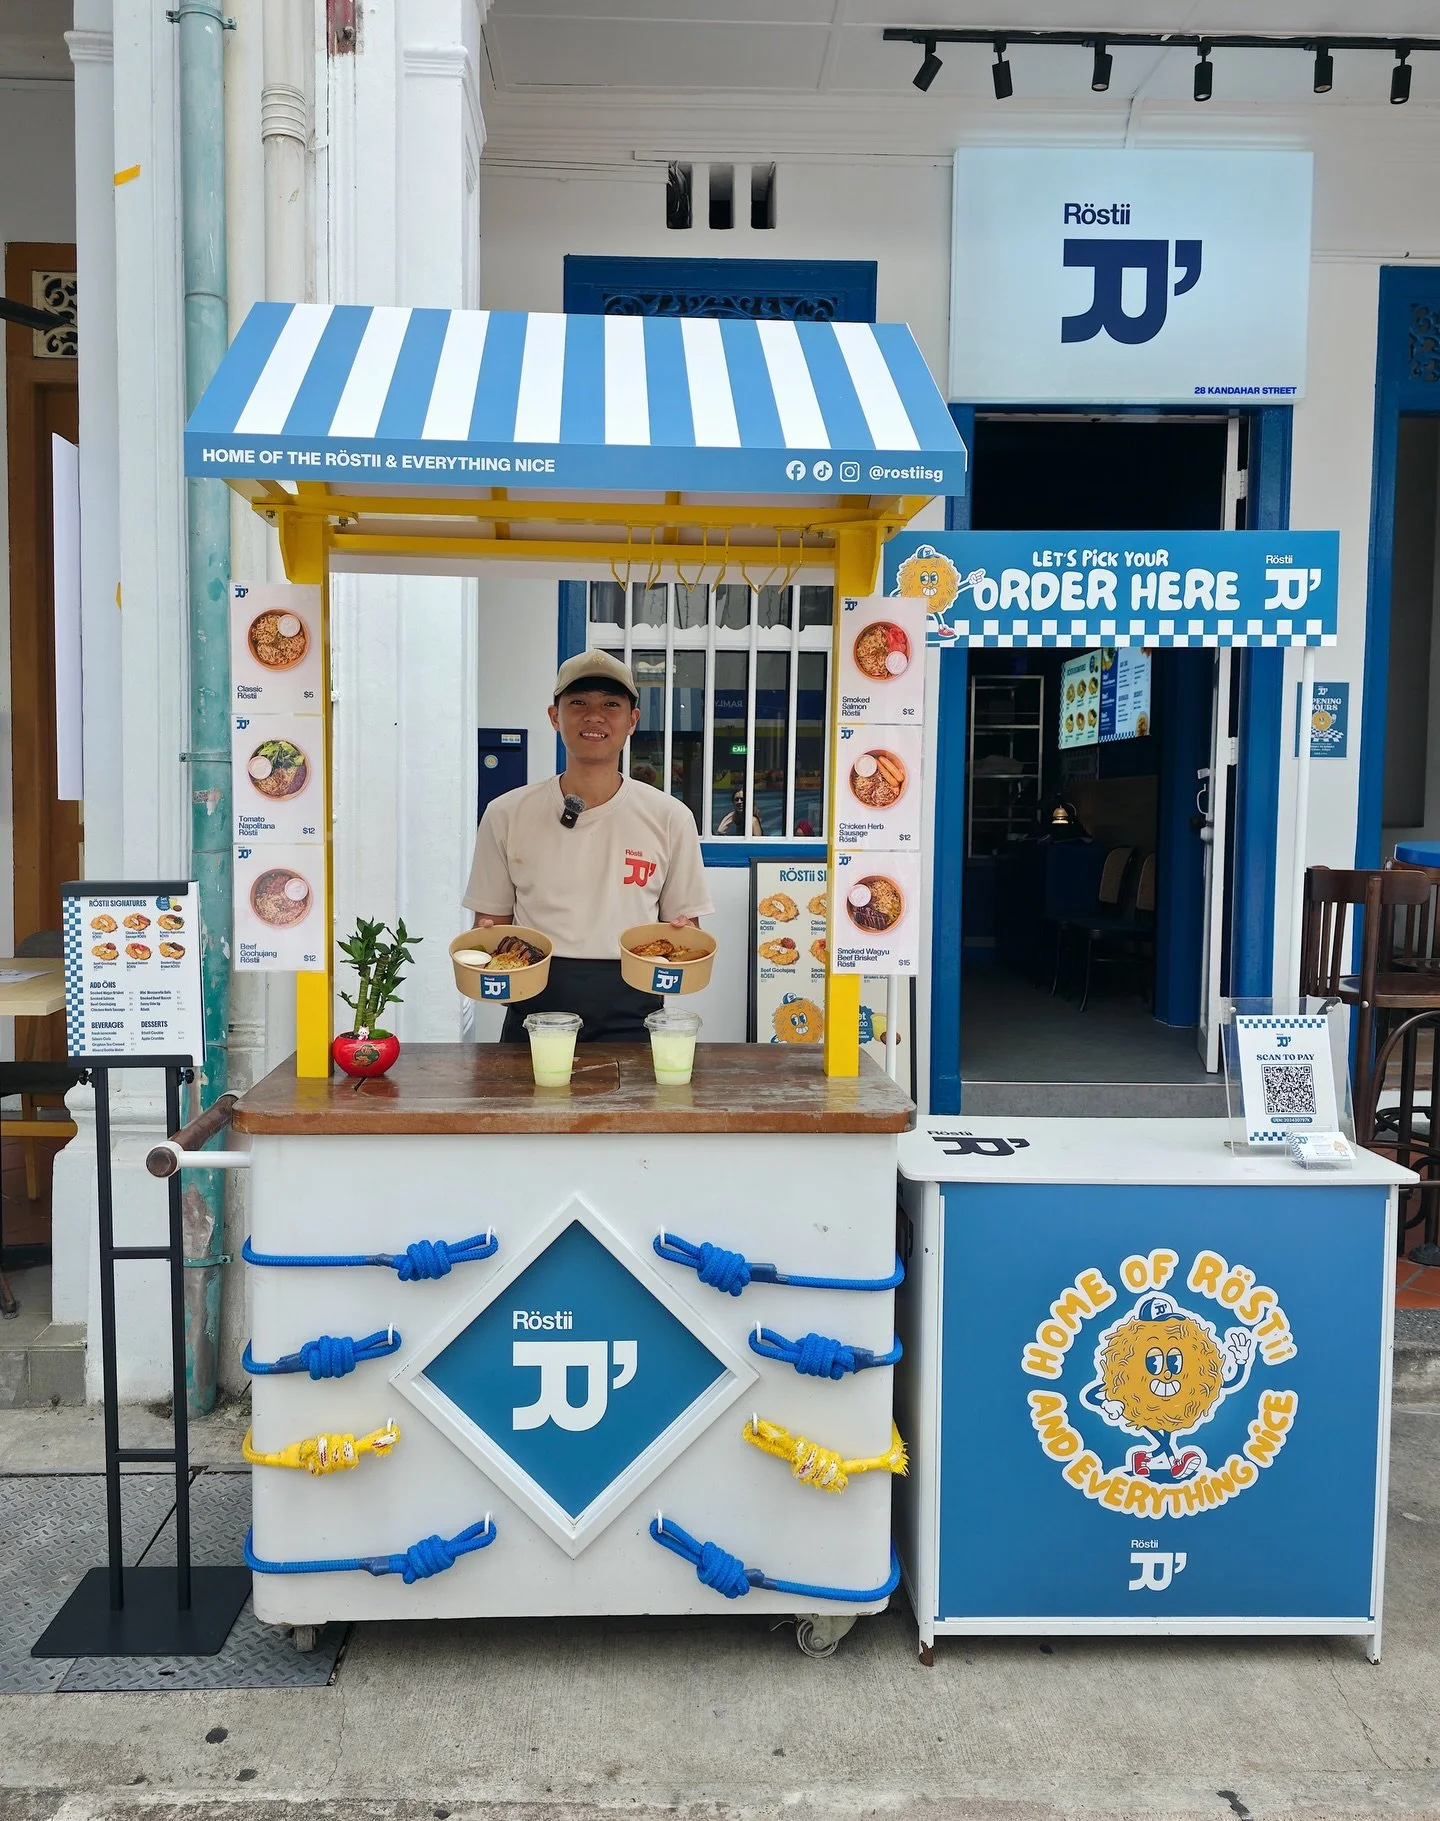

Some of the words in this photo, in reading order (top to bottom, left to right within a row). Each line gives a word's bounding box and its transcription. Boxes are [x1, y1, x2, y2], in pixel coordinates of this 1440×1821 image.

[1063, 203, 1131, 225] Röstii
[203, 449, 255, 464] HOME
[259, 450, 283, 464] OF
[287, 451, 321, 465] THE
[325, 450, 381, 468] RÖSTII
[385, 455, 397, 468] &
[402, 455, 510, 472] EVERYTHING
[515, 458, 555, 473] NICE
[869, 465, 944, 483] @rostiisg
[1123, 550, 1169, 567] YOUR
[1266, 555, 1294, 564] Röstii
[972, 568, 1118, 612] ORDER
[1130, 570, 1240, 612] HERE
[237, 685, 263, 693] Classic
[303, 690, 314, 699] $5
[842, 696, 870, 704] Smoked
[902, 708, 914, 716] $12
[238, 822, 275, 830] Napolitana
[302, 827, 315, 835] $12
[240, 950, 277, 958] Gochujang
[866, 948, 890, 957] Wagyu
[837, 954, 853, 962] Beef
[854, 954, 878, 962] Brisket
[1256, 1053, 1280, 1061] SCAN
[1282, 1053, 1295, 1061] TO
[1297, 1053, 1314, 1061] PAY
[1025, 1272, 1112, 1376] HOME
[1124, 1253, 1175, 1289] OF
[513, 1310, 573, 1330] Röstii
[1032, 1394, 1079, 1457] AND
[1131, 1540, 1159, 1549] Röstii
